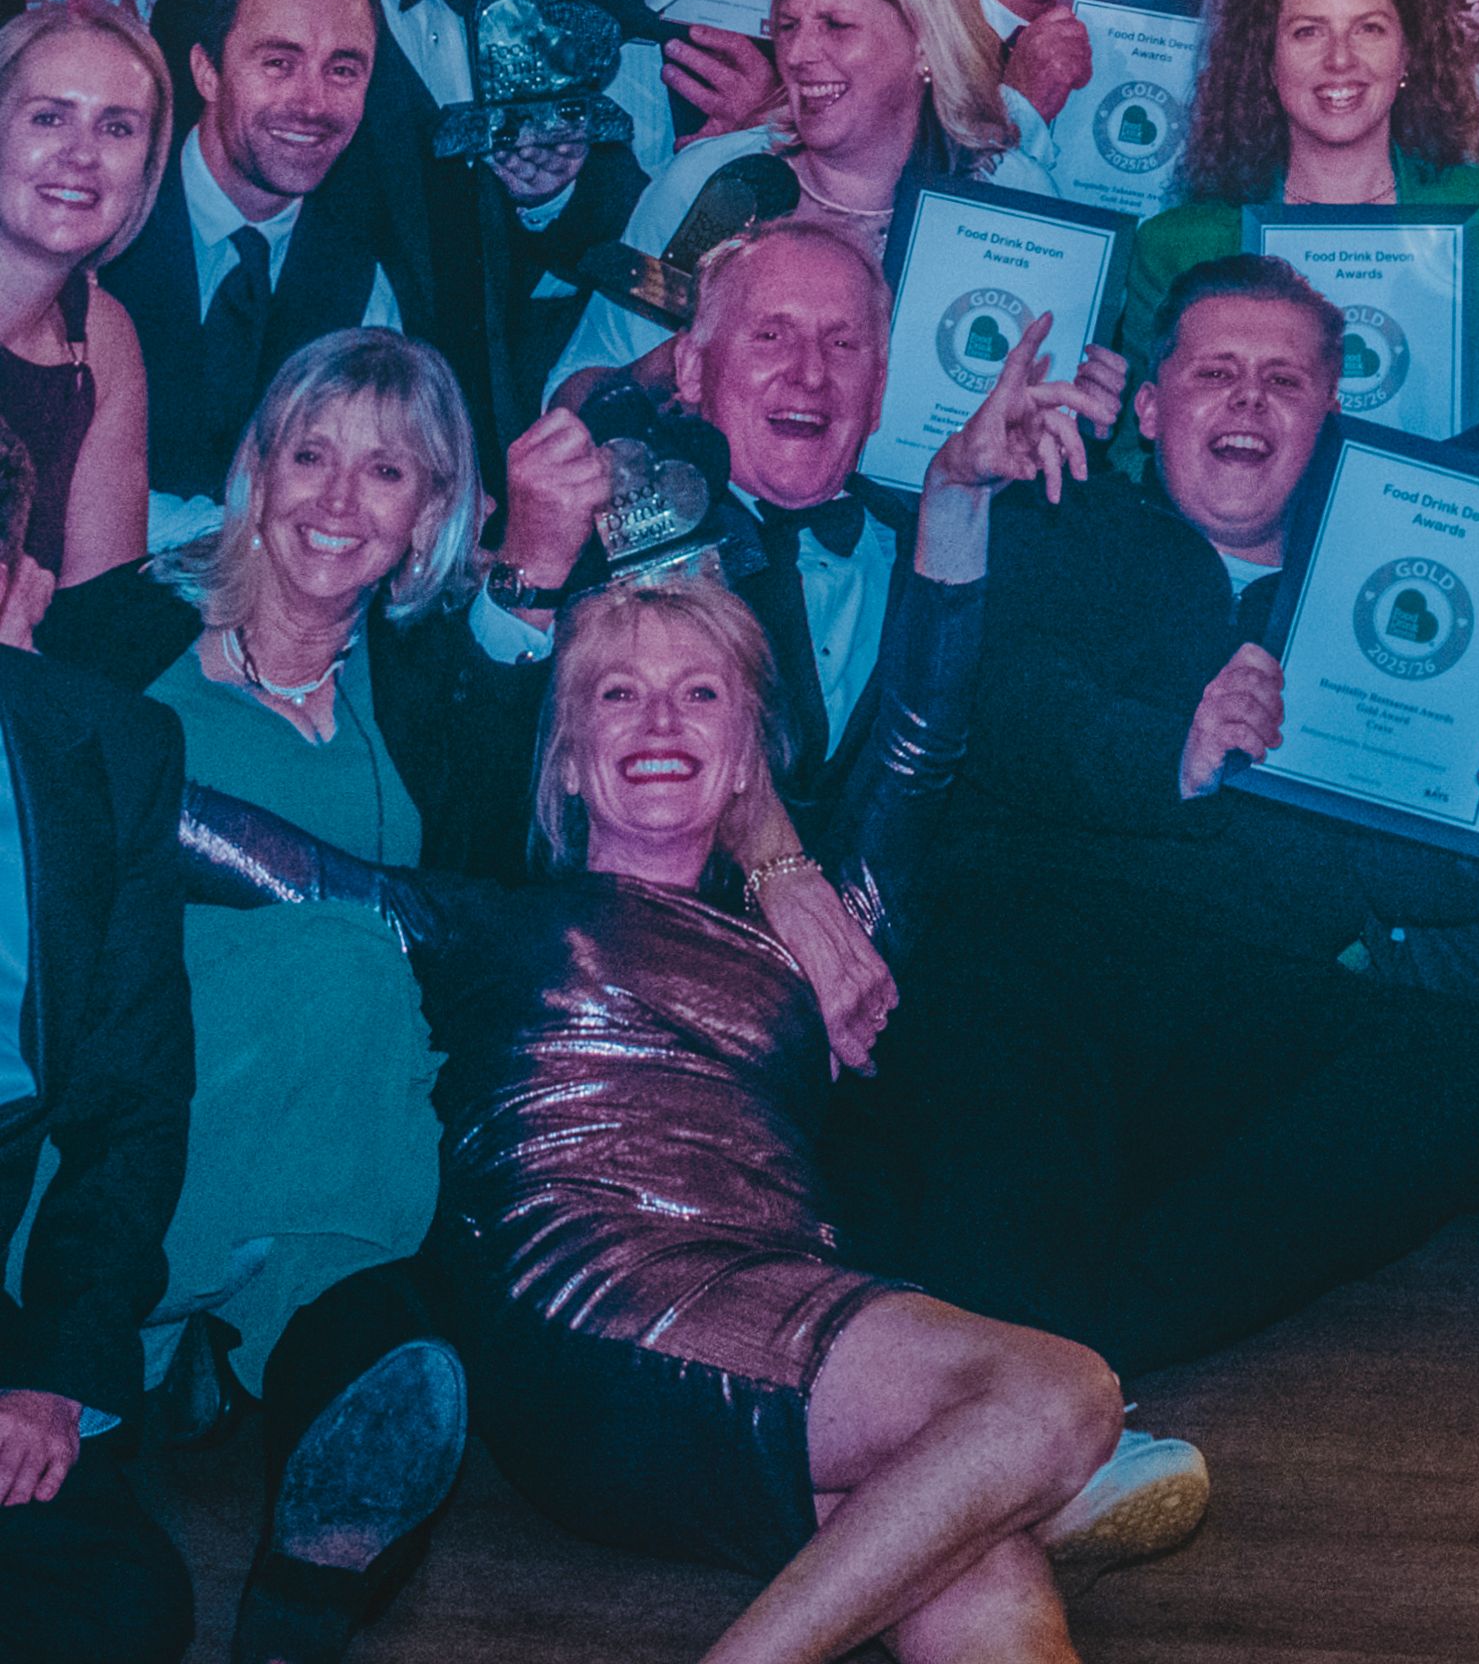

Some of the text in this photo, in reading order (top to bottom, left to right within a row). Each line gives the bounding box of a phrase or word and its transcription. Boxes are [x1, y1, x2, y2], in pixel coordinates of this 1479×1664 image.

[1382, 482, 1420, 504] Food
[1419, 493, 1460, 516] Drink
[1411, 511, 1467, 539] Awards
[1396, 561, 1456, 590] GOLD
[1368, 645, 1436, 678] 2025/26
